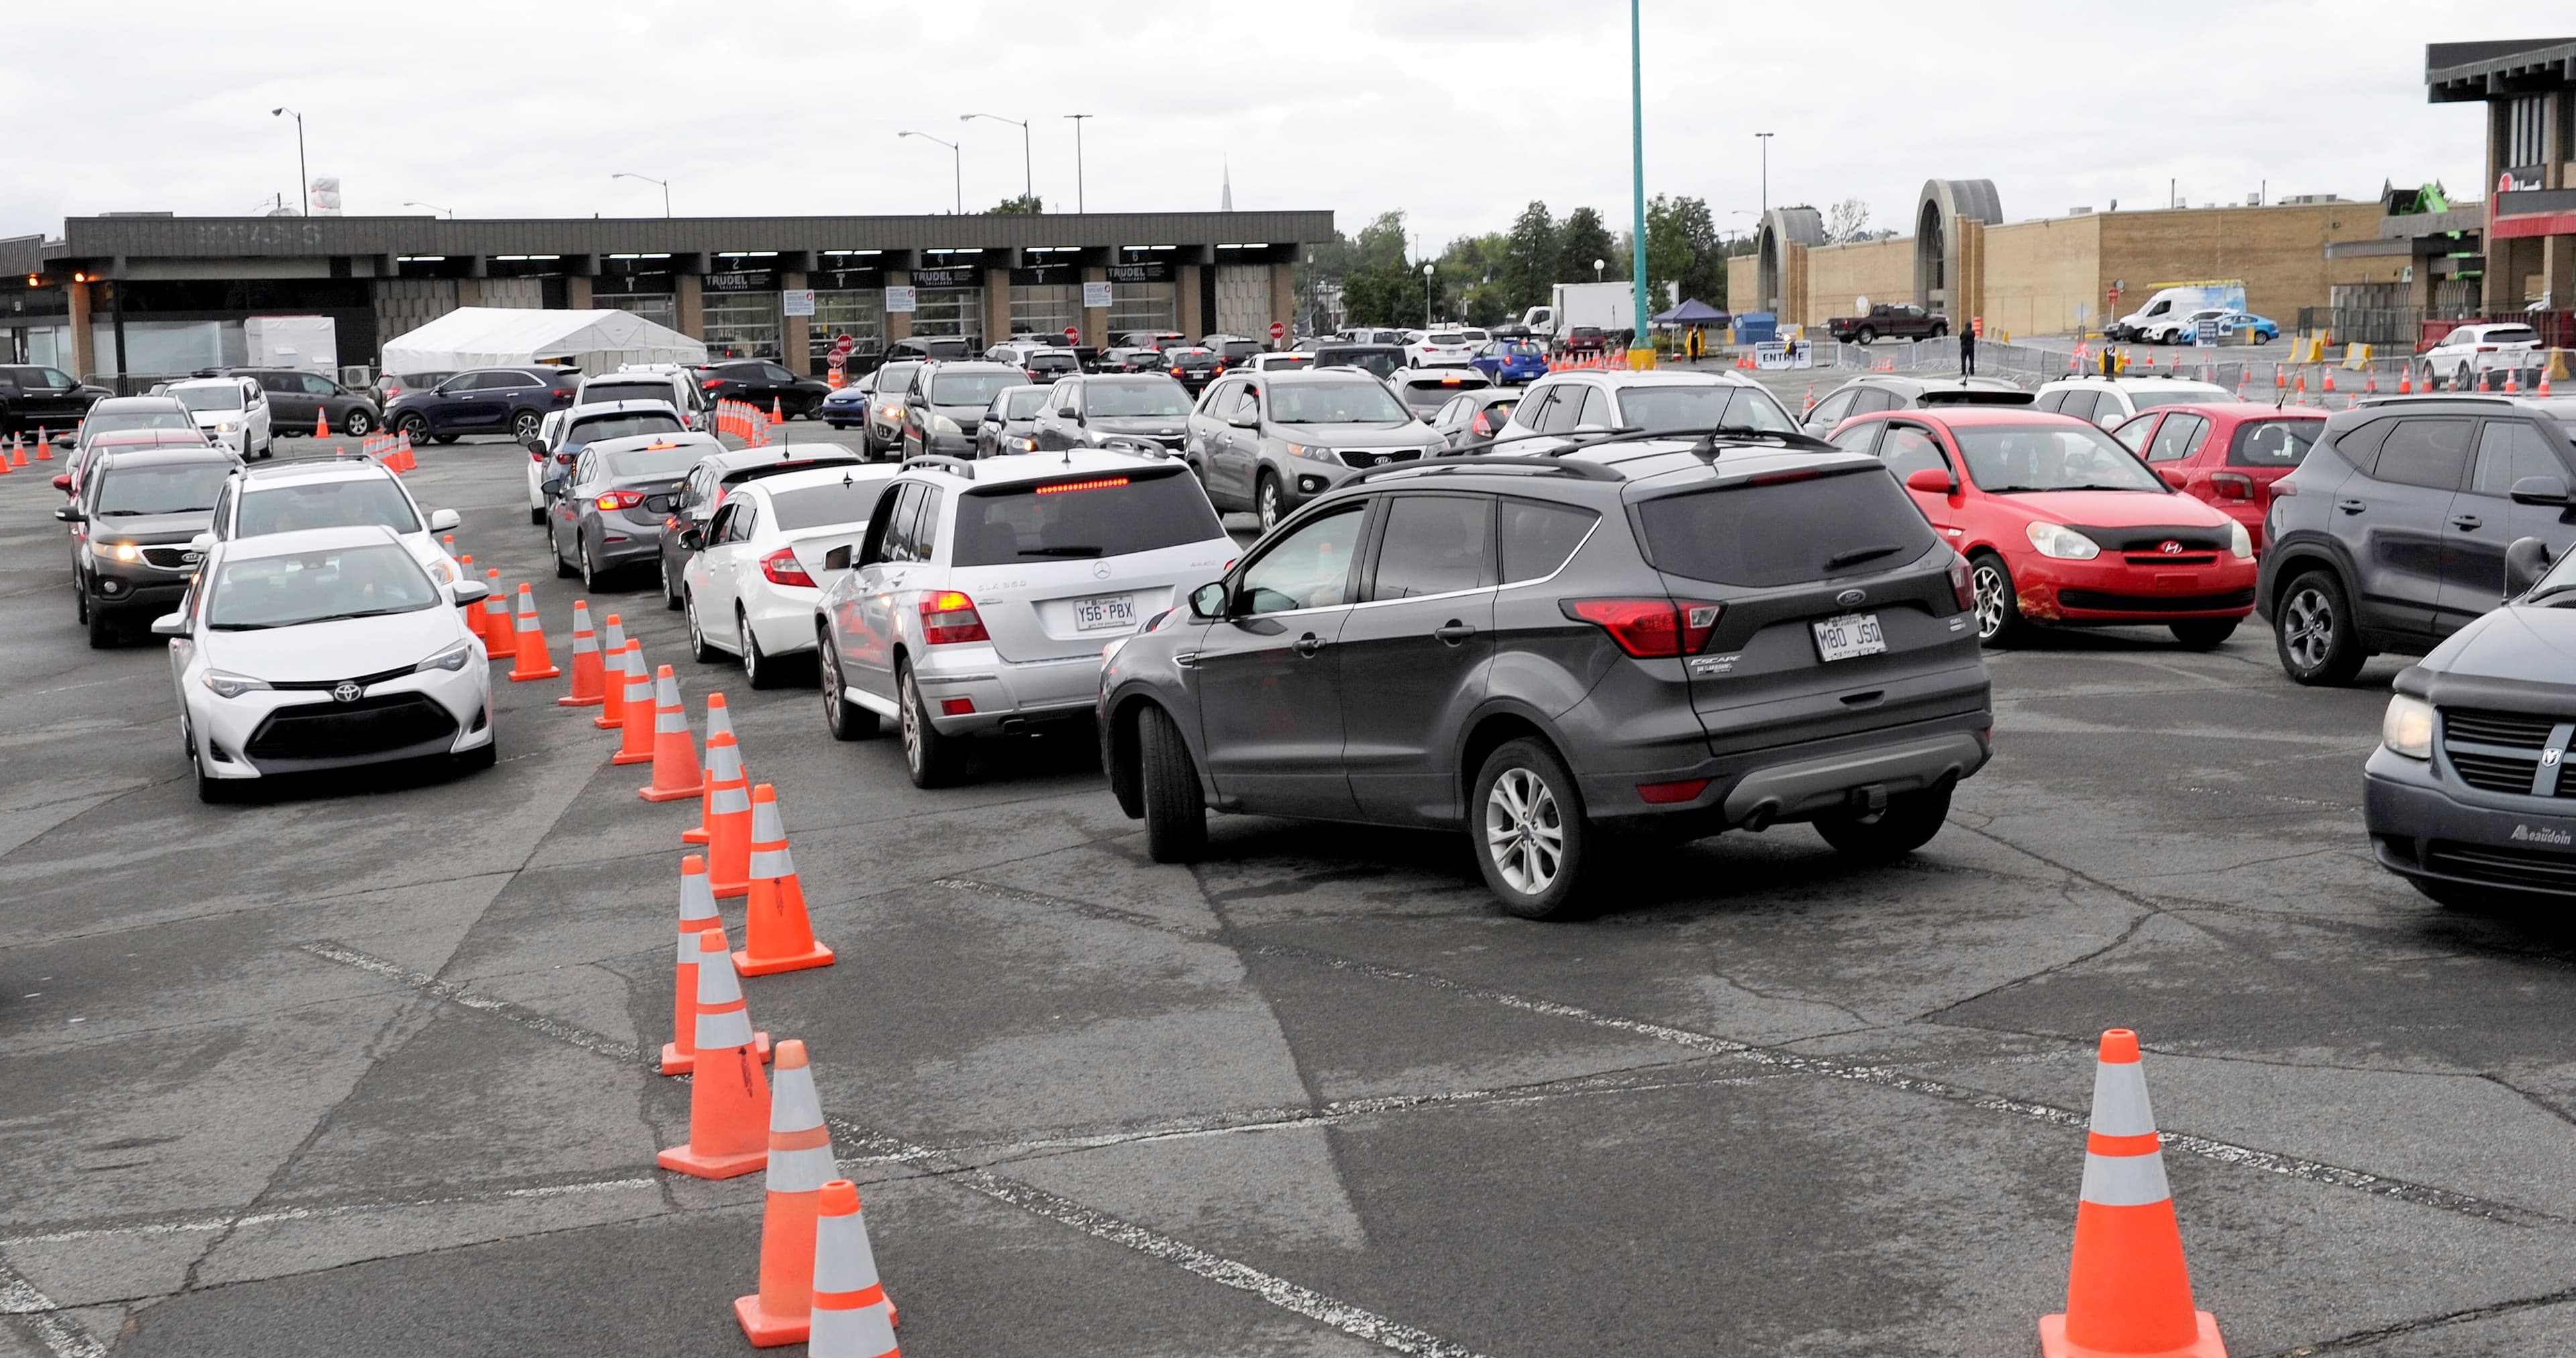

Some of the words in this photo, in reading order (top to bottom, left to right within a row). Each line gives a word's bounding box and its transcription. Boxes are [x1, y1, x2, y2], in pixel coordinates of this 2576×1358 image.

[837, 256, 843, 267] 3
[936, 254, 944, 266] 4
[1036, 252, 1042, 264] 5
[1132, 250, 1139, 262] 6
[626, 259, 631, 272] 1
[732, 258, 739, 269] 2
[912, 271, 952, 282] TRUDEL
[1036, 269, 1044, 283] T
[1108, 267, 1146, 278] TRUDEL
[625, 276, 635, 292] T
[706, 274, 747, 286] TRUDEL
[836, 273, 845, 288] T
[1763, 352, 1804, 363] ENTRE
[1079, 606, 1102, 623] Y56
[1109, 603, 1133, 619] PBX
[1856, 623, 1882, 645] JSQ
[1690, 655, 1741, 666] ESCAPE
